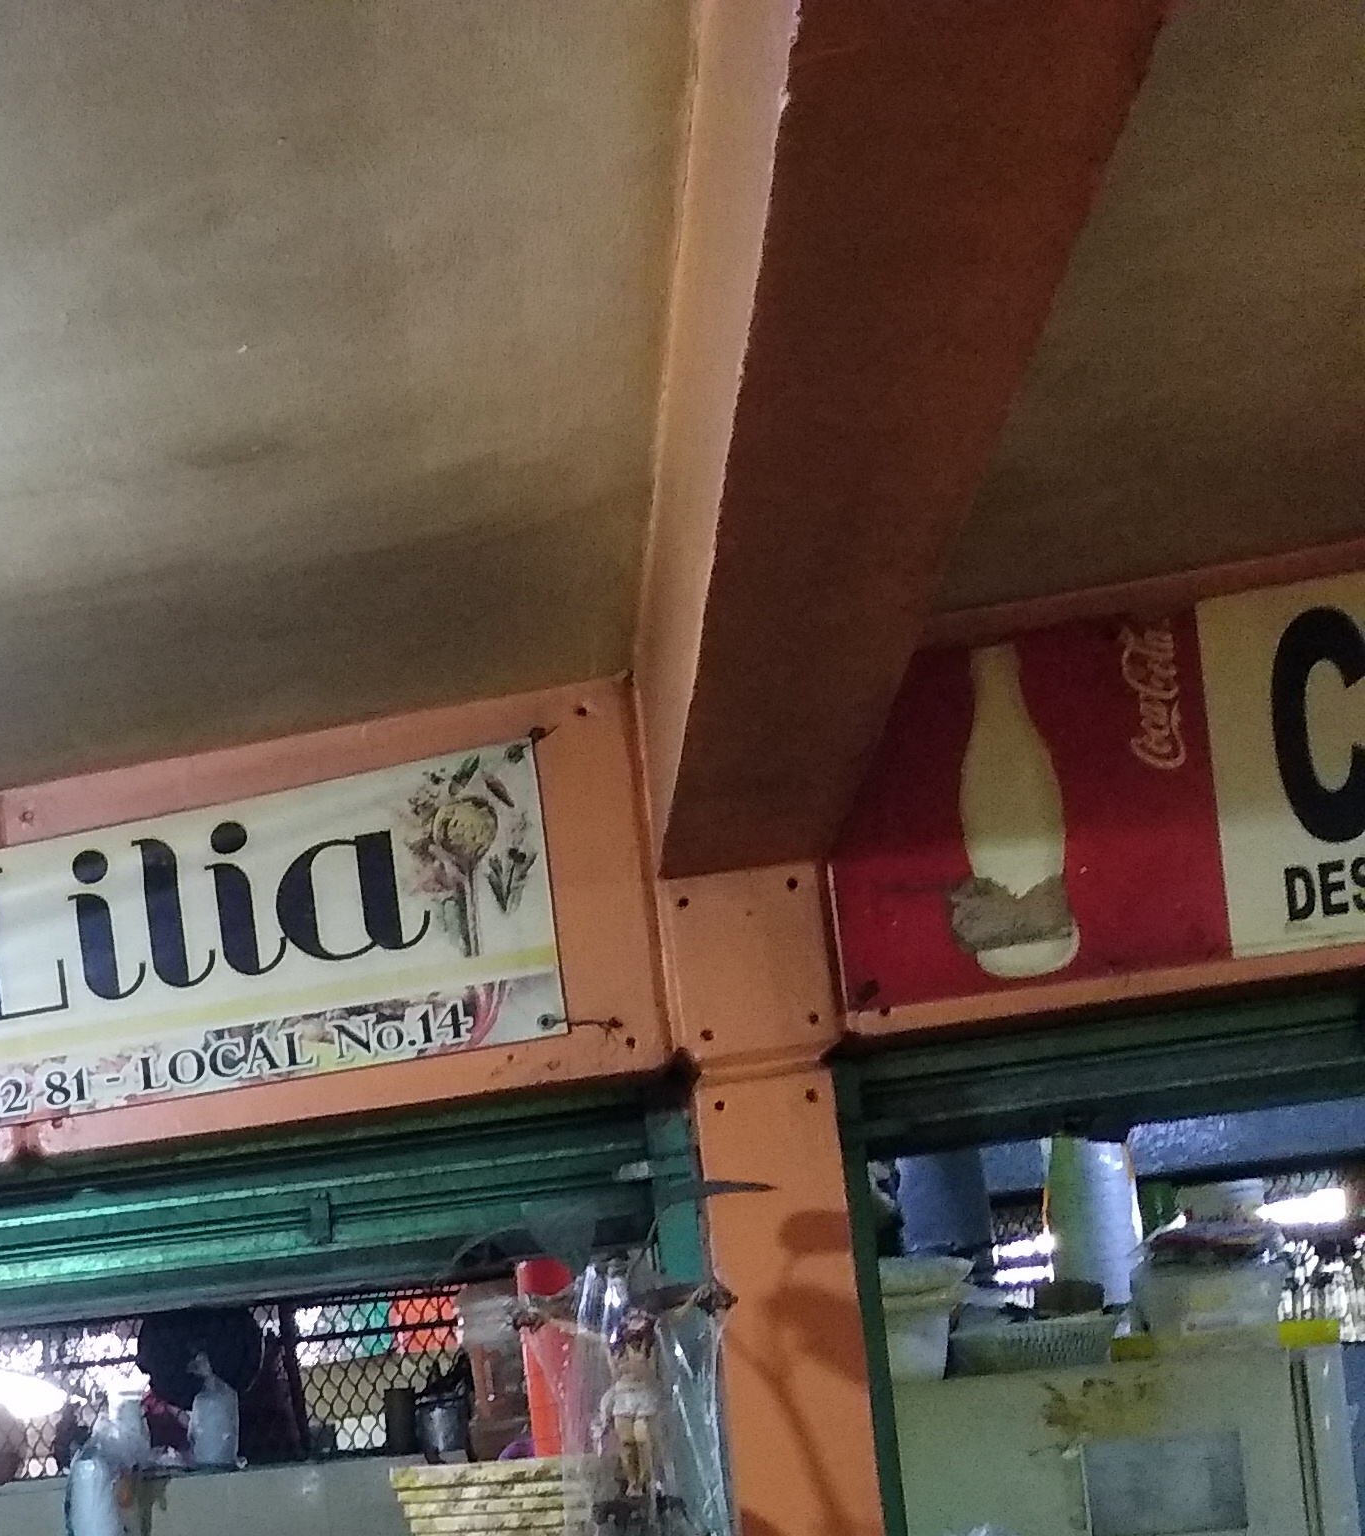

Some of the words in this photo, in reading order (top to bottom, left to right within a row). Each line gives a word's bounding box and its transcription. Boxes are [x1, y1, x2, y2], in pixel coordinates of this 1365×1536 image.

[44, 1066, 88, 1106] 81
[140, 1032, 314, 1091] LOCAL
[332, 1003, 469, 1059] No.14
